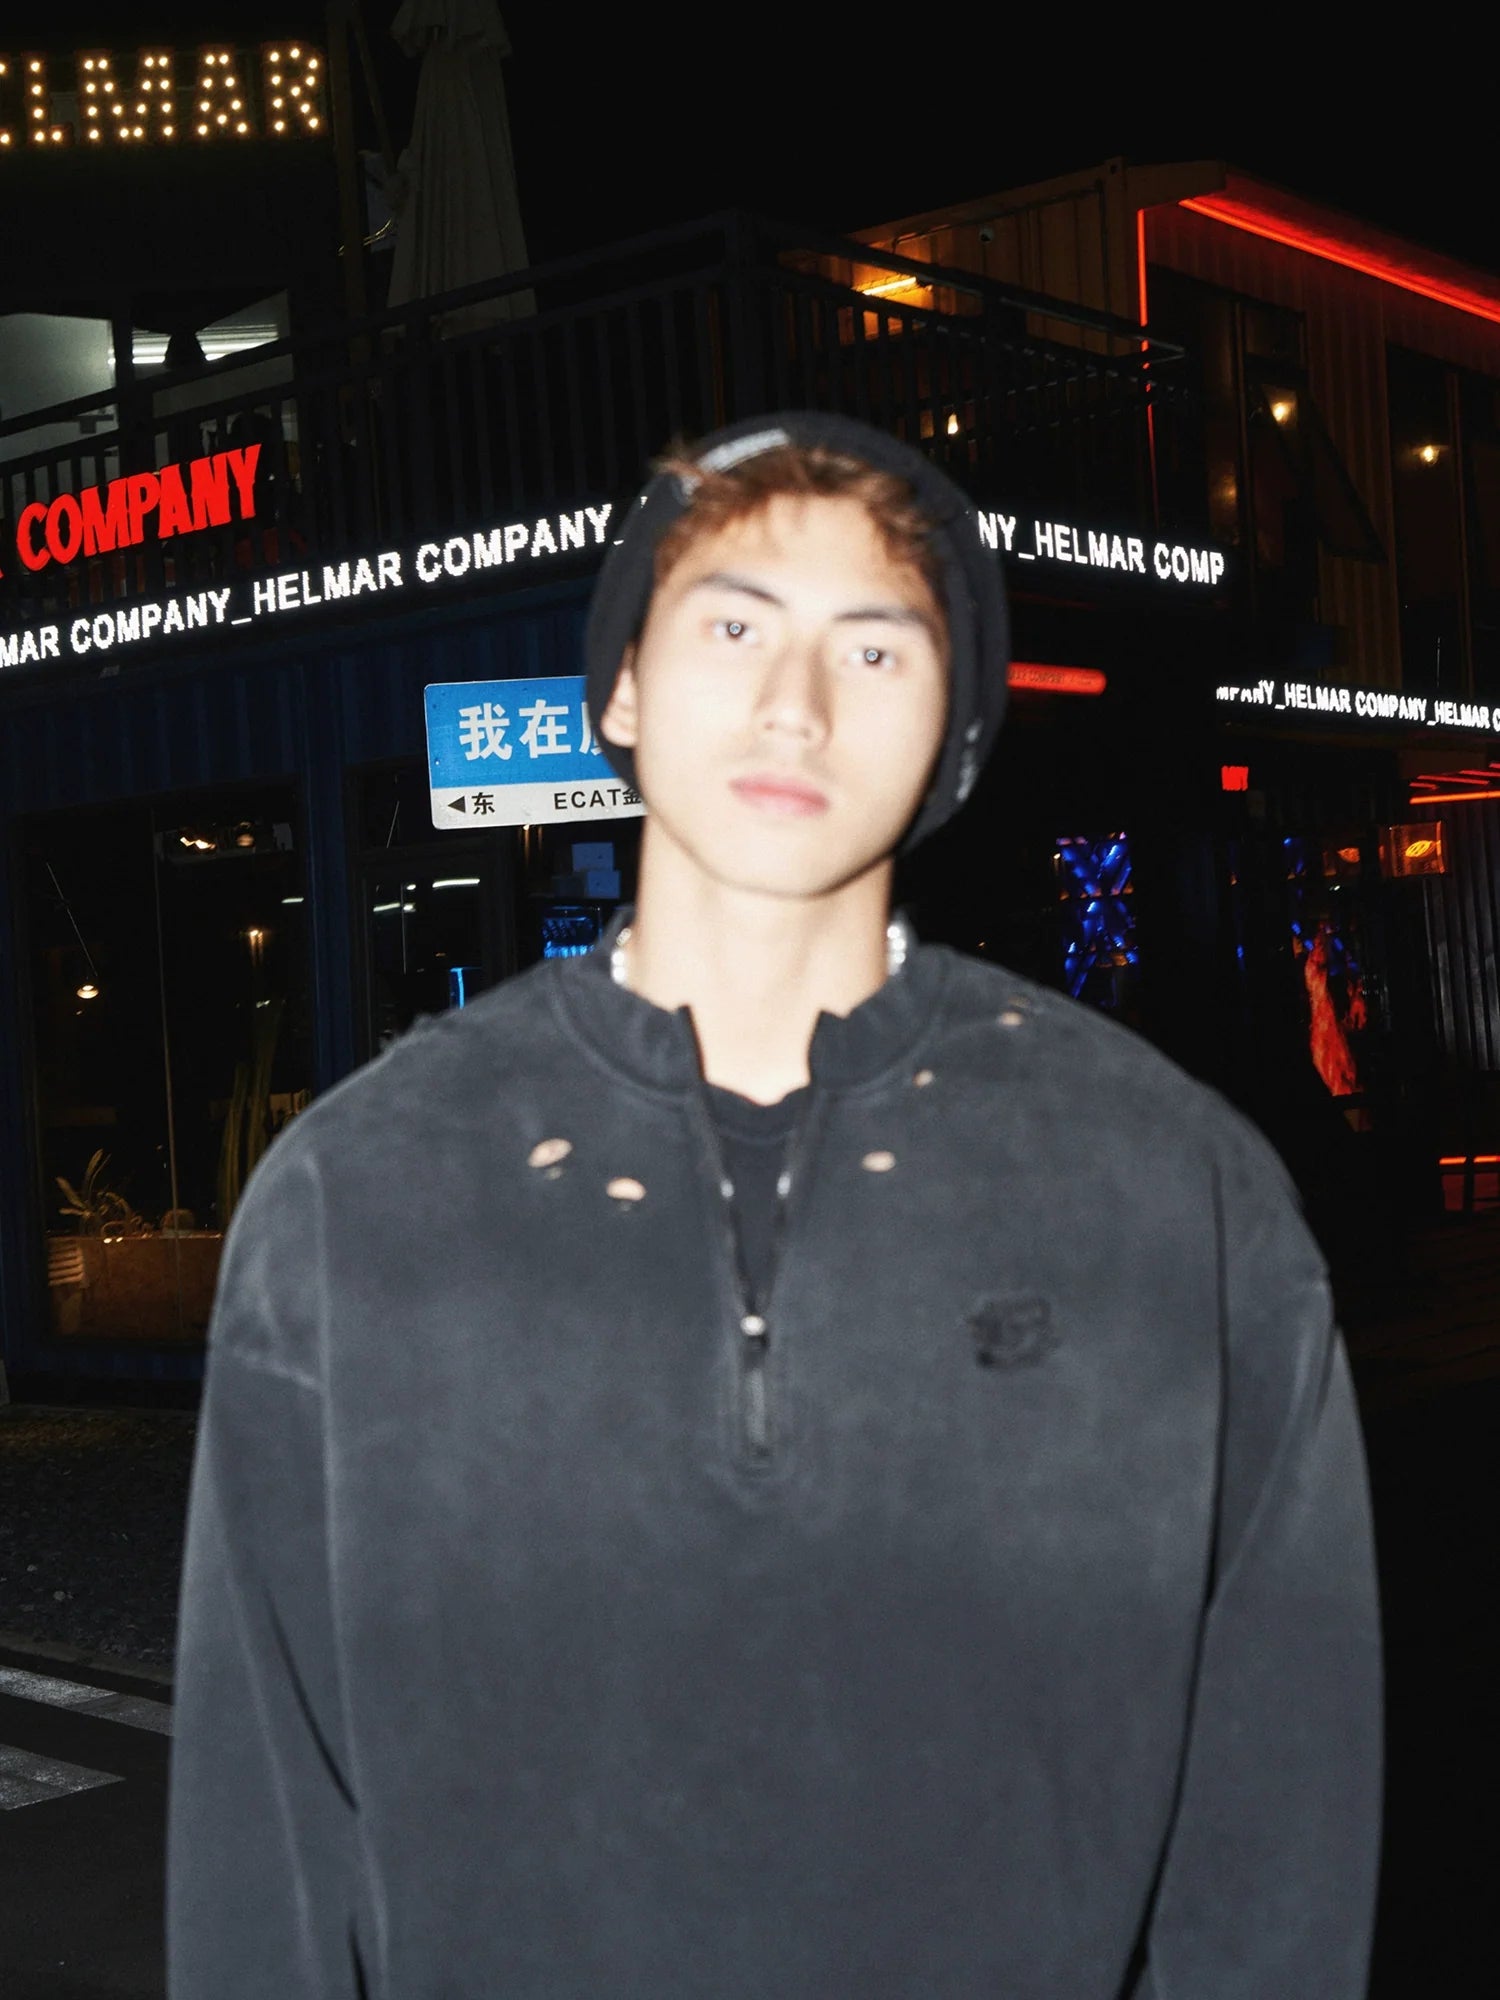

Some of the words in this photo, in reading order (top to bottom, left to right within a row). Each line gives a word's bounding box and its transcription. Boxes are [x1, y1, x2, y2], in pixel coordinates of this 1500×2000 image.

[16, 444, 261, 571] COMPANY
[1153, 542, 1225, 585] COMP
[471, 792, 496, 815] 东
